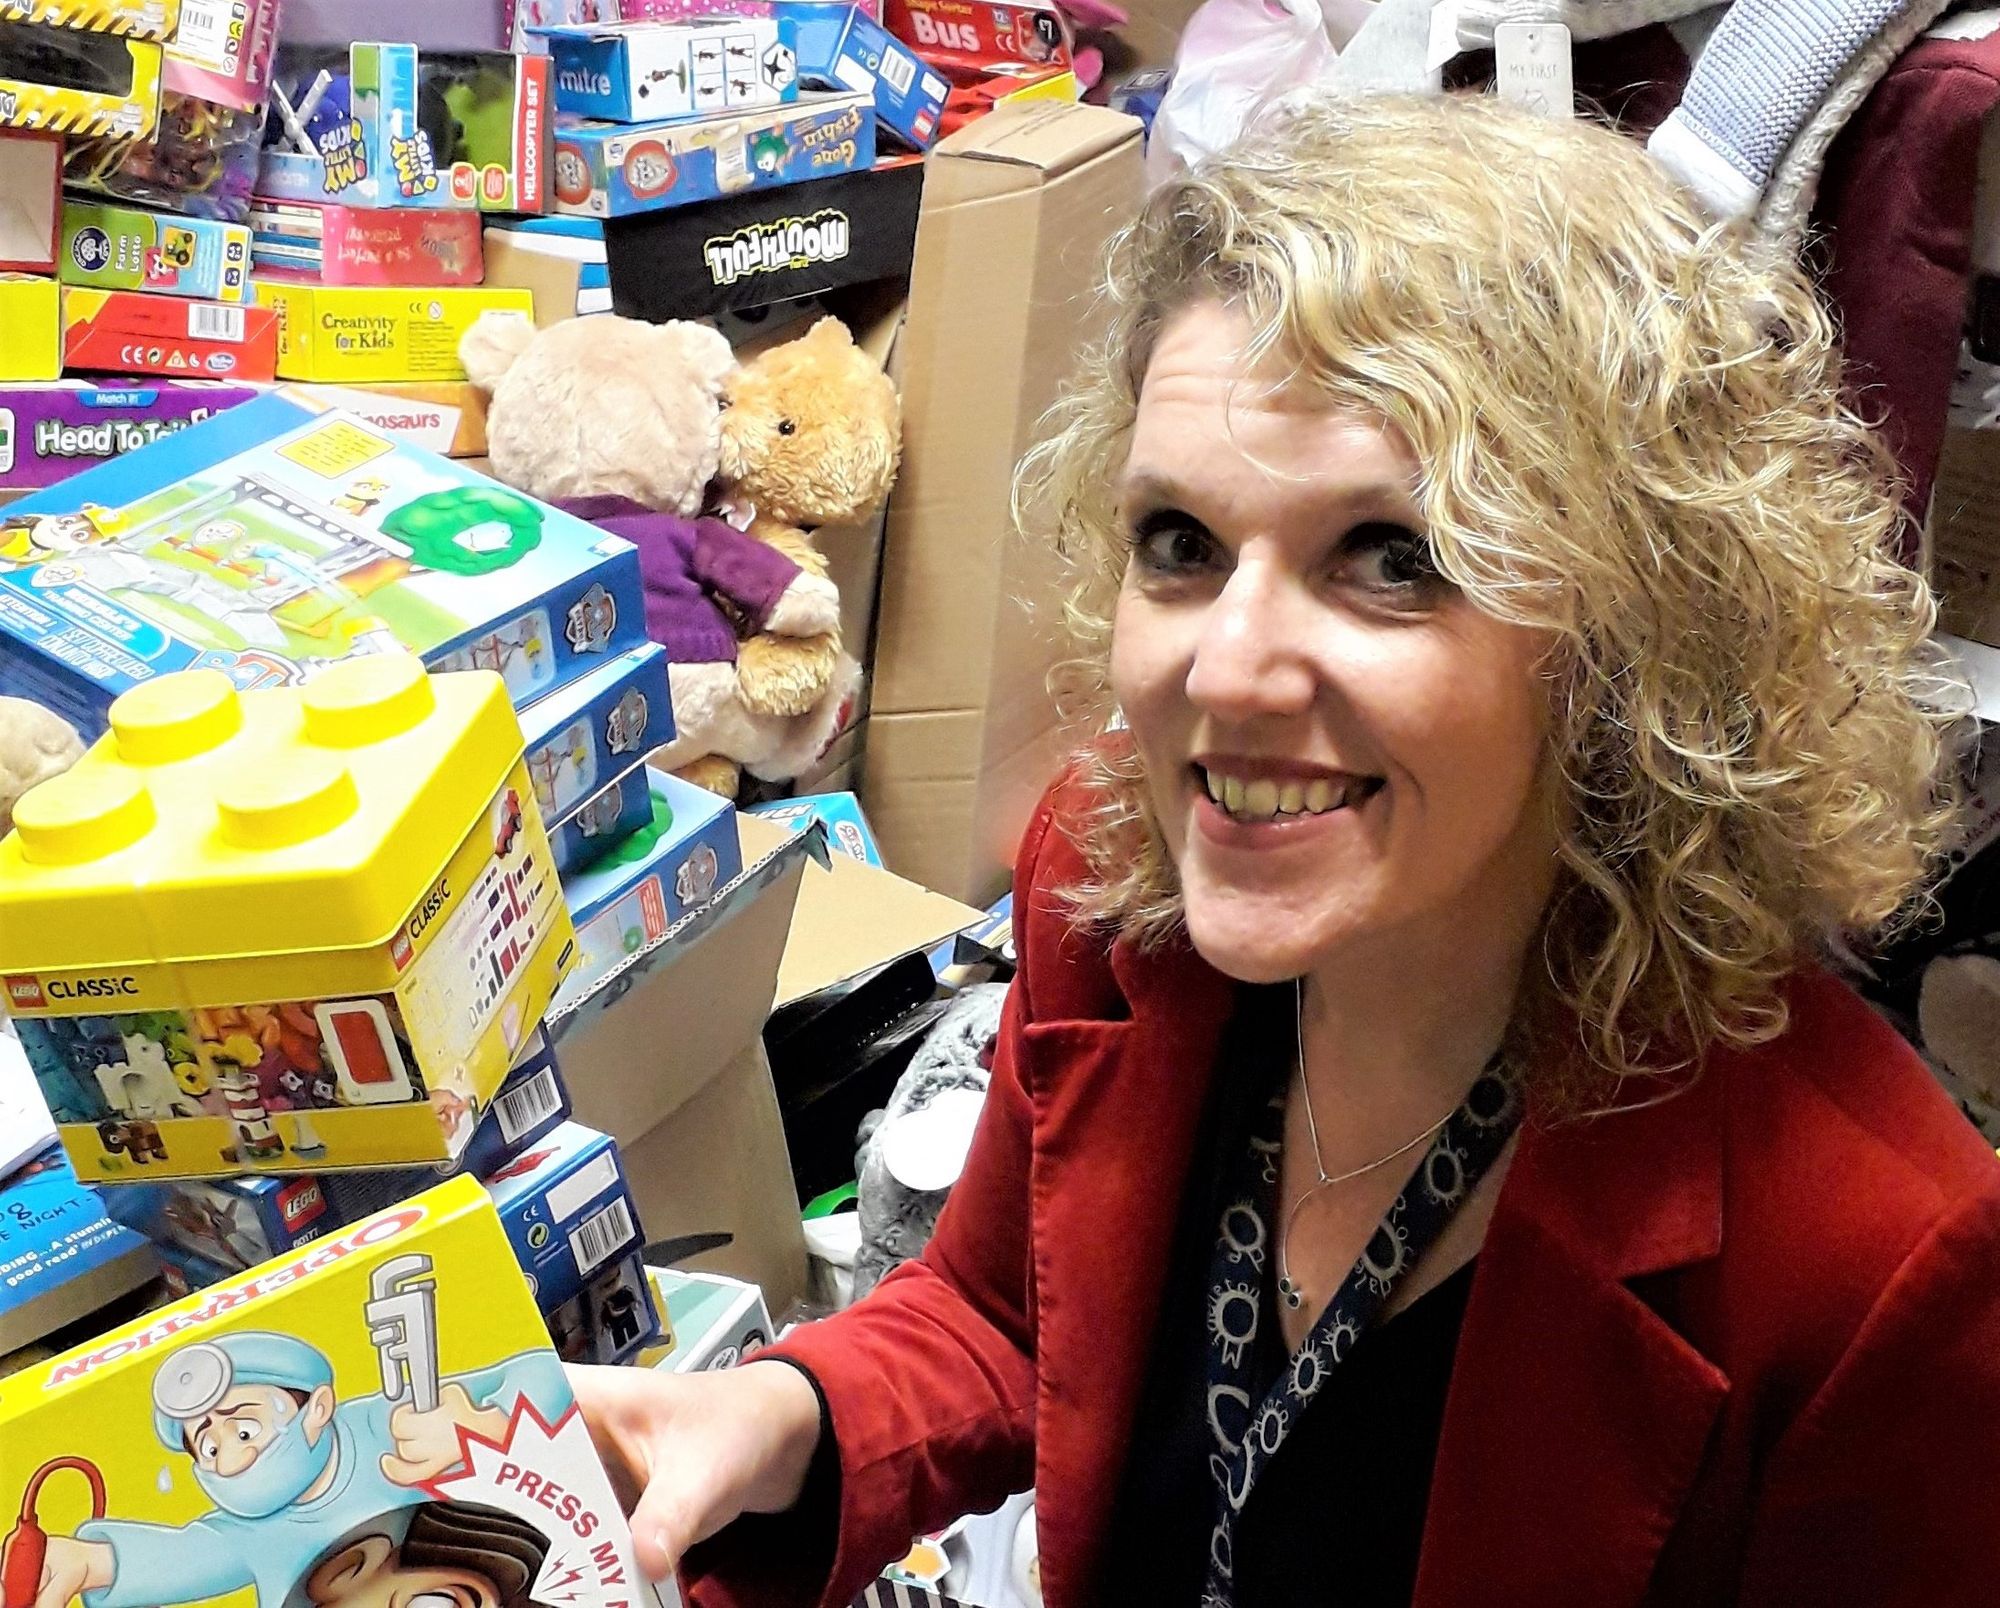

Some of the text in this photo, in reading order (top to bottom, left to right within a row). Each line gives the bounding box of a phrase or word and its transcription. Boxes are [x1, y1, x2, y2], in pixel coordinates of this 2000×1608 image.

[911, 10, 981, 51] Bus
[558, 67, 611, 96] mitre
[319, 125, 351, 154] KIDS
[417, 130, 435, 177] KIDS
[524, 79, 538, 200] HELICOPTER SET
[812, 142, 856, 168] Gone
[324, 164, 357, 193] MY
[391, 138, 415, 183] MY
[115, 235, 128, 271] Farm
[130, 235, 142, 273] Lotto
[710, 218, 847, 282] MOUTHFULL
[322, 313, 398, 332] Creativity
[336, 330, 394, 350] for Kids
[39, 421, 112, 453] Head
[114, 423, 144, 450] To
[285, 1184, 324, 1221] LEGO
[7, 1263, 44, 1287] good
[46, 1207, 426, 1388] OPERATION
[495, 1462, 626, 1588] PRESS MY
